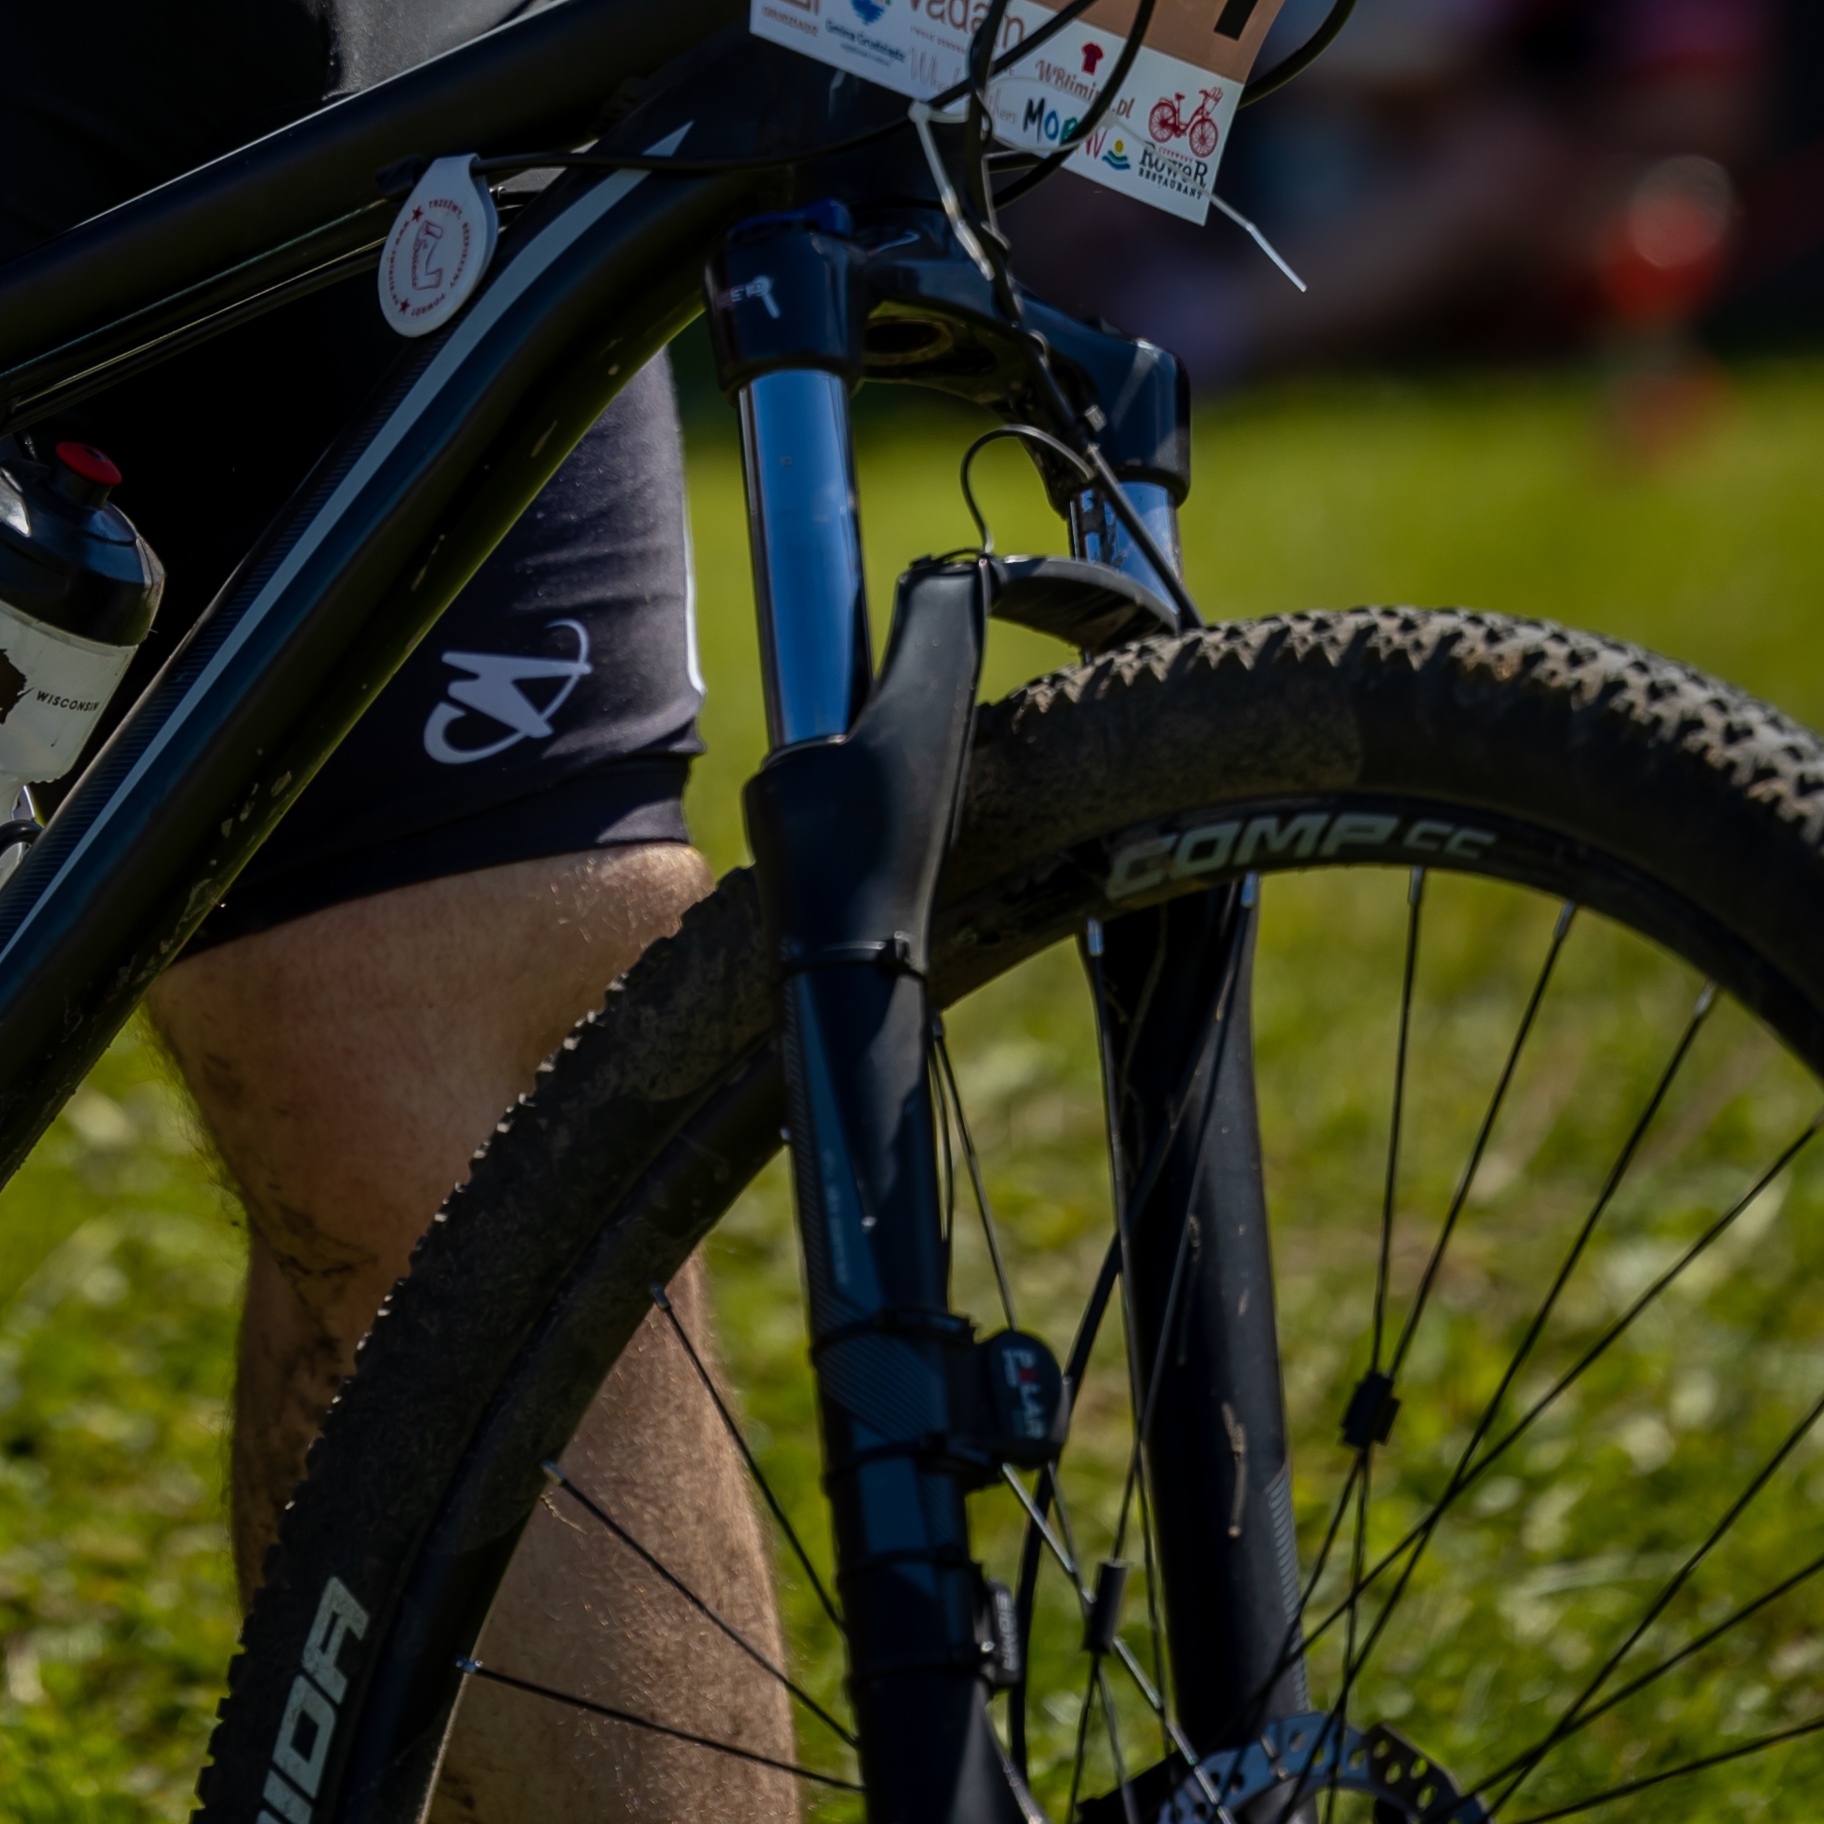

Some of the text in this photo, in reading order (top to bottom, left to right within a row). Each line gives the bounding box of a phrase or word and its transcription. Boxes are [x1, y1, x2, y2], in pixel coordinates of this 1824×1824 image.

[1138, 167, 1205, 201] RESTAURANT
[35, 689, 100, 712] WISCONSIN
[1105, 810, 1499, 902] COMP CC
